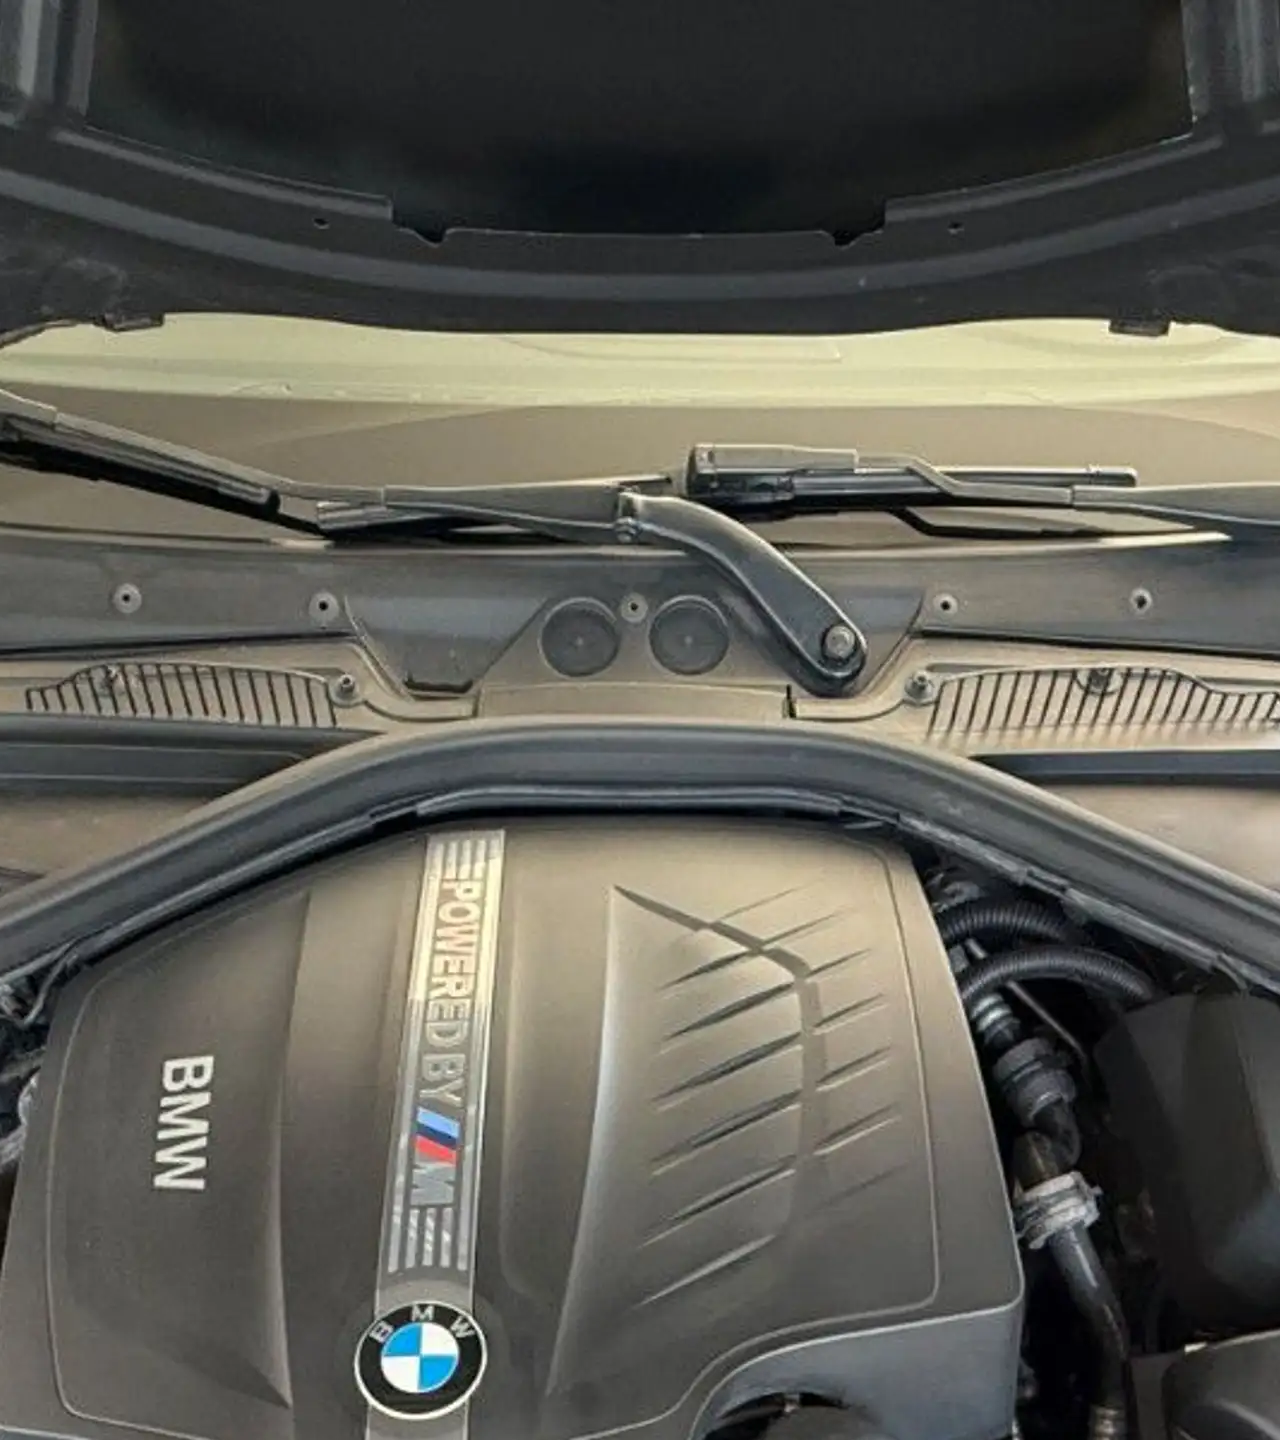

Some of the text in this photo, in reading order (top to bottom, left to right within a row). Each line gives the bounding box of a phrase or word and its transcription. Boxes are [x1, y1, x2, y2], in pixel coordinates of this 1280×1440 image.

[425, 879, 484, 1049] POWERED
[153, 1055, 215, 1190] BMW
[419, 1053, 466, 1108] BY
[368, 1304, 476, 1344] BMW
